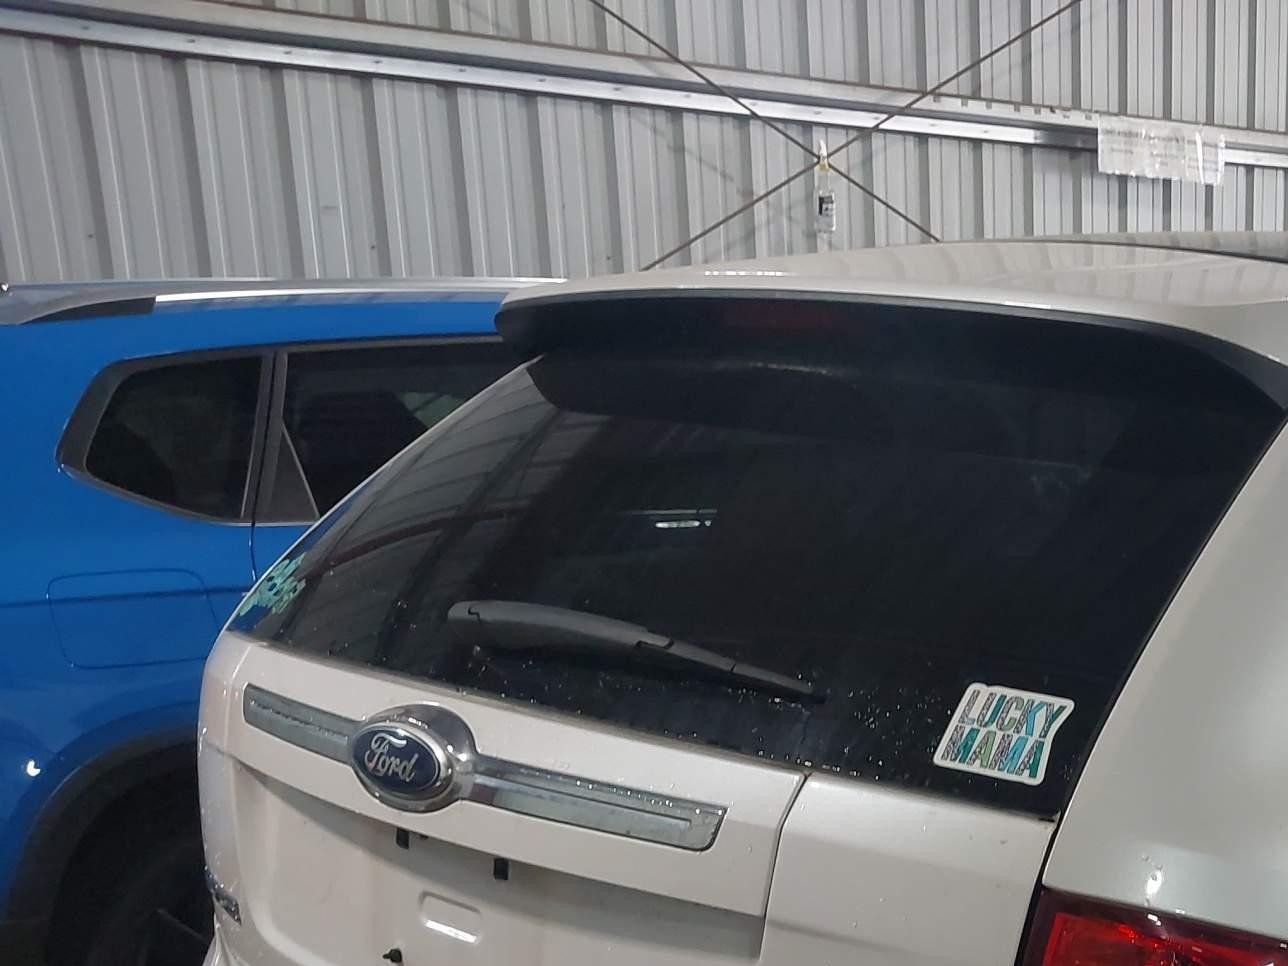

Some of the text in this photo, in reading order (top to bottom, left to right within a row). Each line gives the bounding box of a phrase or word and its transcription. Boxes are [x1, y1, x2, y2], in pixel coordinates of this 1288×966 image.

[958, 689, 1068, 739] LUCKY
[364, 732, 419, 783] Ford
[940, 724, 1045, 779] MAMA
